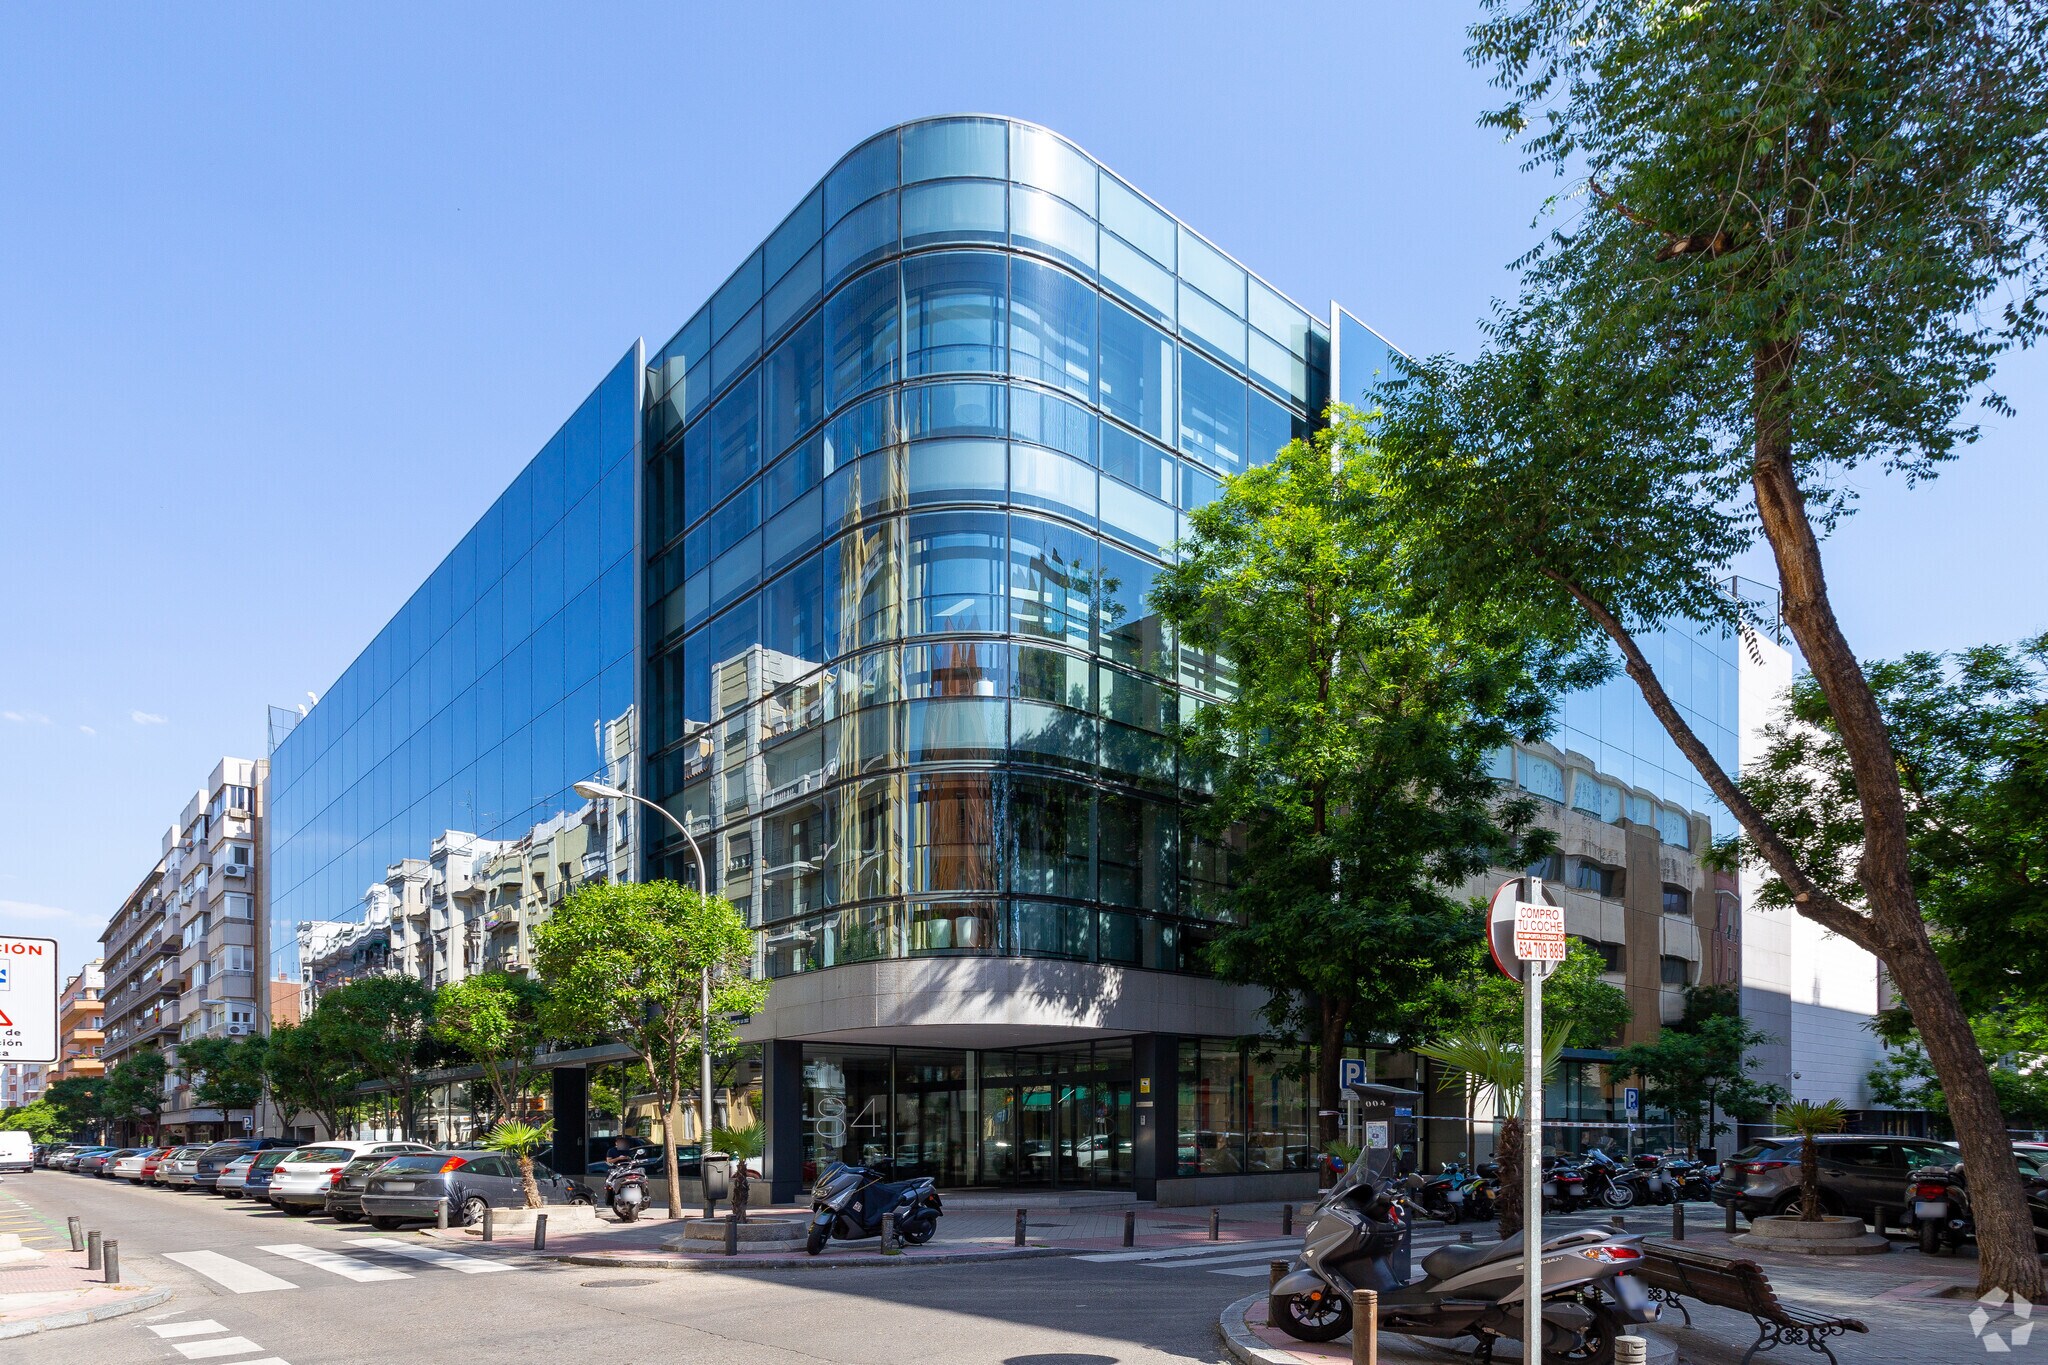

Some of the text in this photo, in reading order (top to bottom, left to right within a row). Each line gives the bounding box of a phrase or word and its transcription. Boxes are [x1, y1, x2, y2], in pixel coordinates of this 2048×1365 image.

[1521, 907, 1559, 920] COMPRO
[1518, 920, 1563, 932] TU COCHE
[0, 942, 42, 955] IÓN
[1520, 942, 1564, 959] 634 709 889
[1346, 1063, 1360, 1085] P
[1628, 1092, 1636, 1107] P
[244, 1118, 250, 1128] P
[816, 1098, 881, 1138] 84
